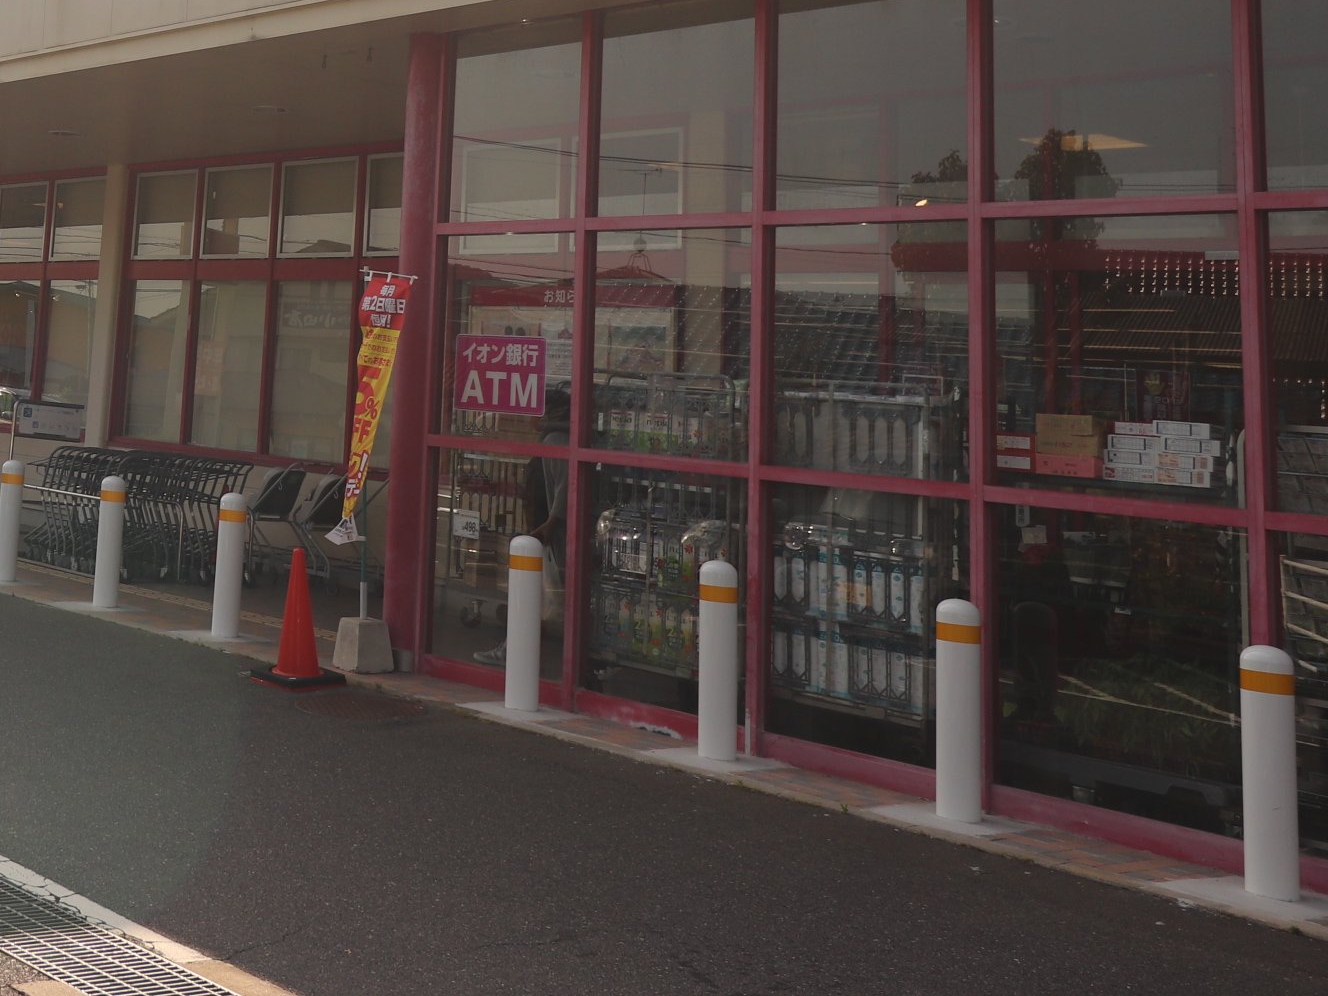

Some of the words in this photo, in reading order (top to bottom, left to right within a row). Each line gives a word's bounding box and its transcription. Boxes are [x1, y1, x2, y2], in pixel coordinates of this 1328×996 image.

[361, 296, 406, 314] 第2日曜日
[544, 289, 574, 303] お知ら
[463, 343, 539, 367] イオン銀行
[461, 369, 538, 408] ATM
